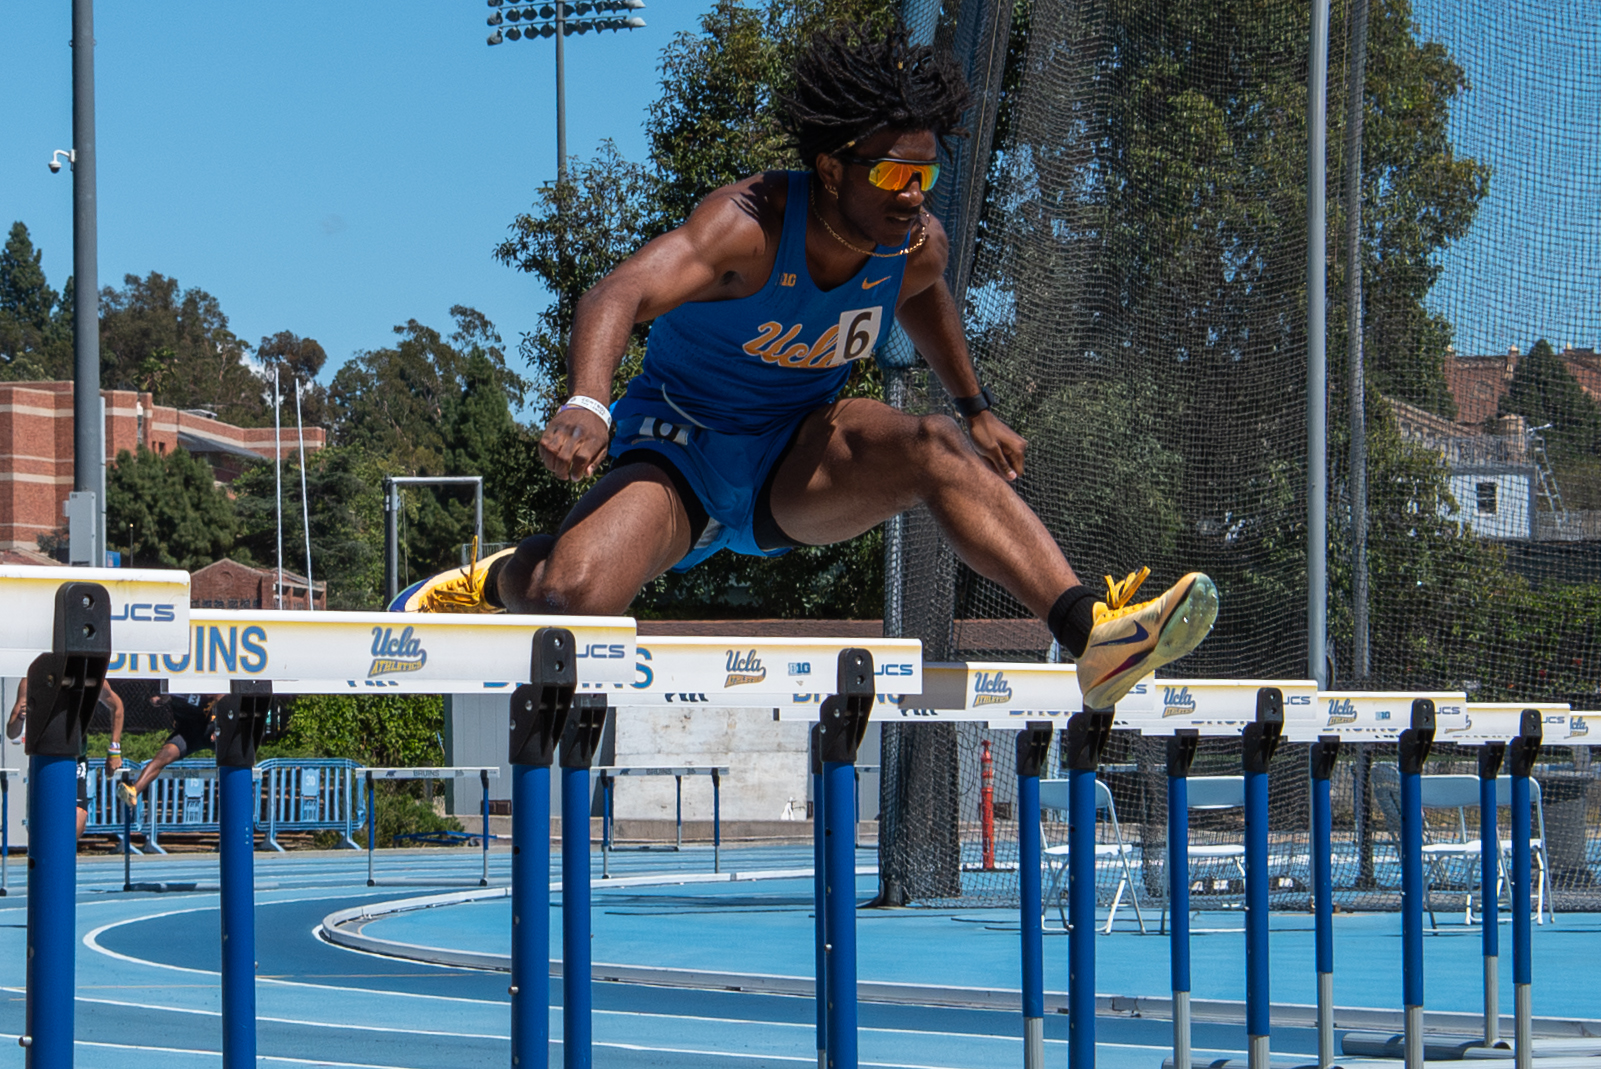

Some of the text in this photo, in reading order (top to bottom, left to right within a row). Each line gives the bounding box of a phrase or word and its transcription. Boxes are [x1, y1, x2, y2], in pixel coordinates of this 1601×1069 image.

[843, 311, 873, 360] 6
[371, 625, 425, 657] Ucla
[725, 649, 763, 672] Ucla
[974, 671, 1009, 693] Ucla
[1163, 686, 1193, 706] Ucla
[1329, 699, 1355, 715] Ucla
